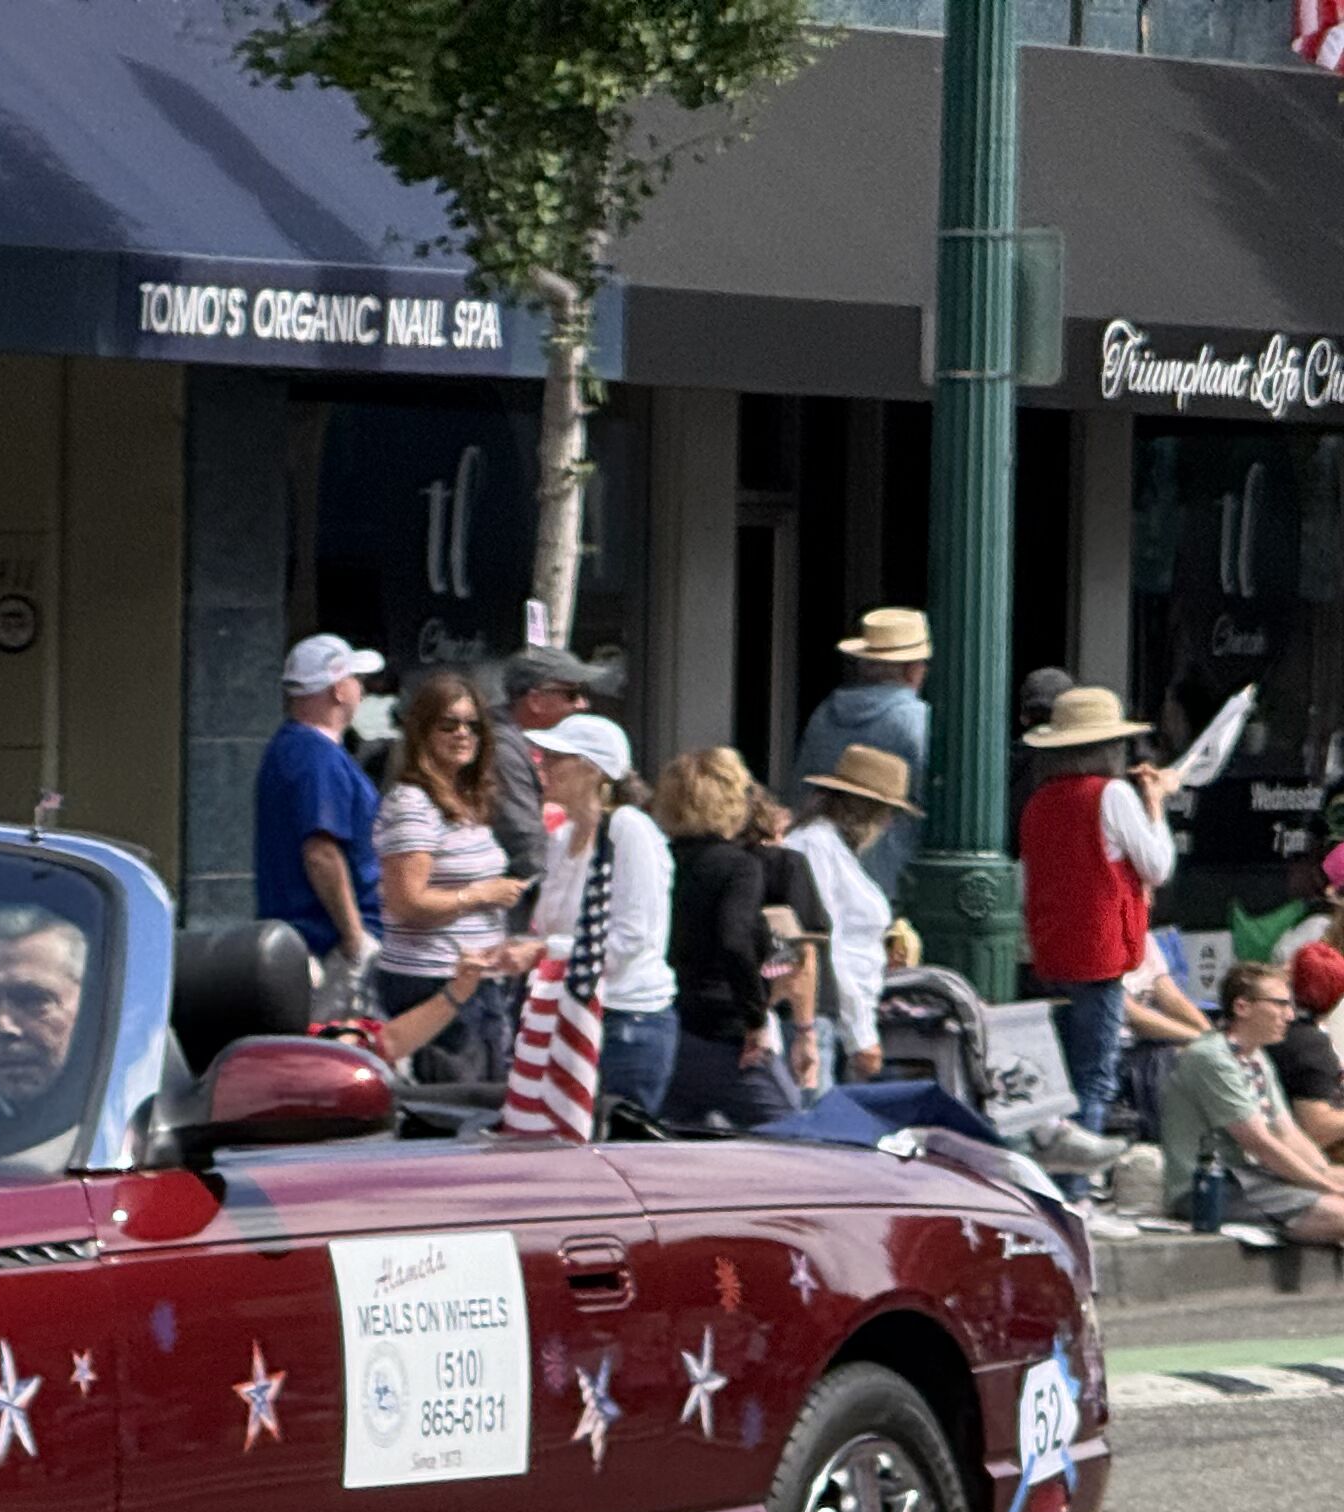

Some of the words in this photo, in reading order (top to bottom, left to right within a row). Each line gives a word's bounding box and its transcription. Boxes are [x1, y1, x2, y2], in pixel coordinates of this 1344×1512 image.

[139, 282, 247, 337] TOMO'S
[252, 289, 381, 345] ORGANIC
[387, 298, 447, 347] NAIL
[453, 299, 503, 350] SPA
[1102, 319, 1253, 412] Triumphant
[1250, 334, 1301, 418] Life
[357, 1303, 413, 1337] MEALS
[415, 1301, 441, 1333] ON
[442, 1296, 508, 1332] WHEELS
[435, 1348, 483, 1390] (510)
[420, 1393, 506, 1438] 865-6131
[1033, 1386, 1064, 1457] 52
